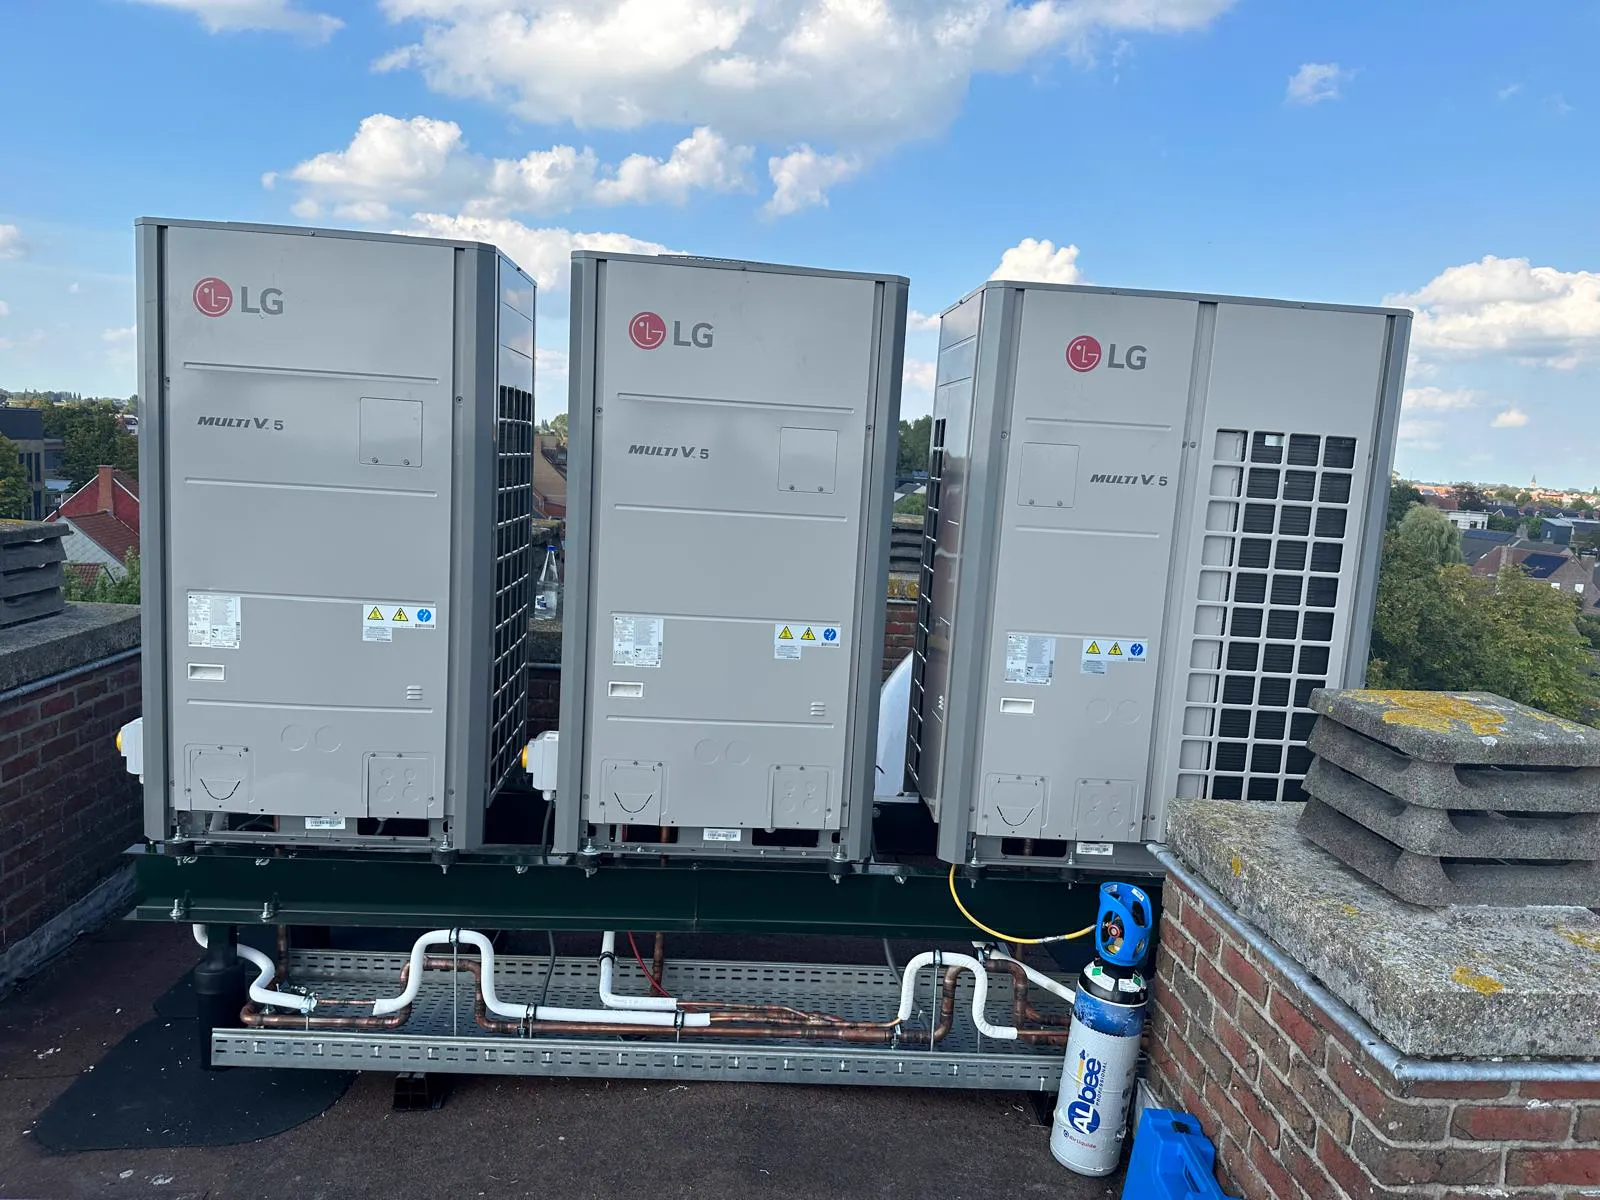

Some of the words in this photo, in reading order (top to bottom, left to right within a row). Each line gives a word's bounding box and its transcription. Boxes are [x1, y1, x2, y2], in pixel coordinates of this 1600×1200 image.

[241, 286, 283, 315] LG
[673, 320, 714, 348] LG
[1107, 343, 1148, 370] LG
[197, 416, 250, 428] MULTI
[273, 420, 284, 430] 5
[628, 444, 678, 457] MULTI
[699, 449, 709, 459] 5
[1089, 474, 1138, 484] MULTI
[1158, 476, 1168, 486] 5
[1069, 1057, 1102, 1135] ALbee
[1095, 1062, 1108, 1106] PROFESSIONAL
